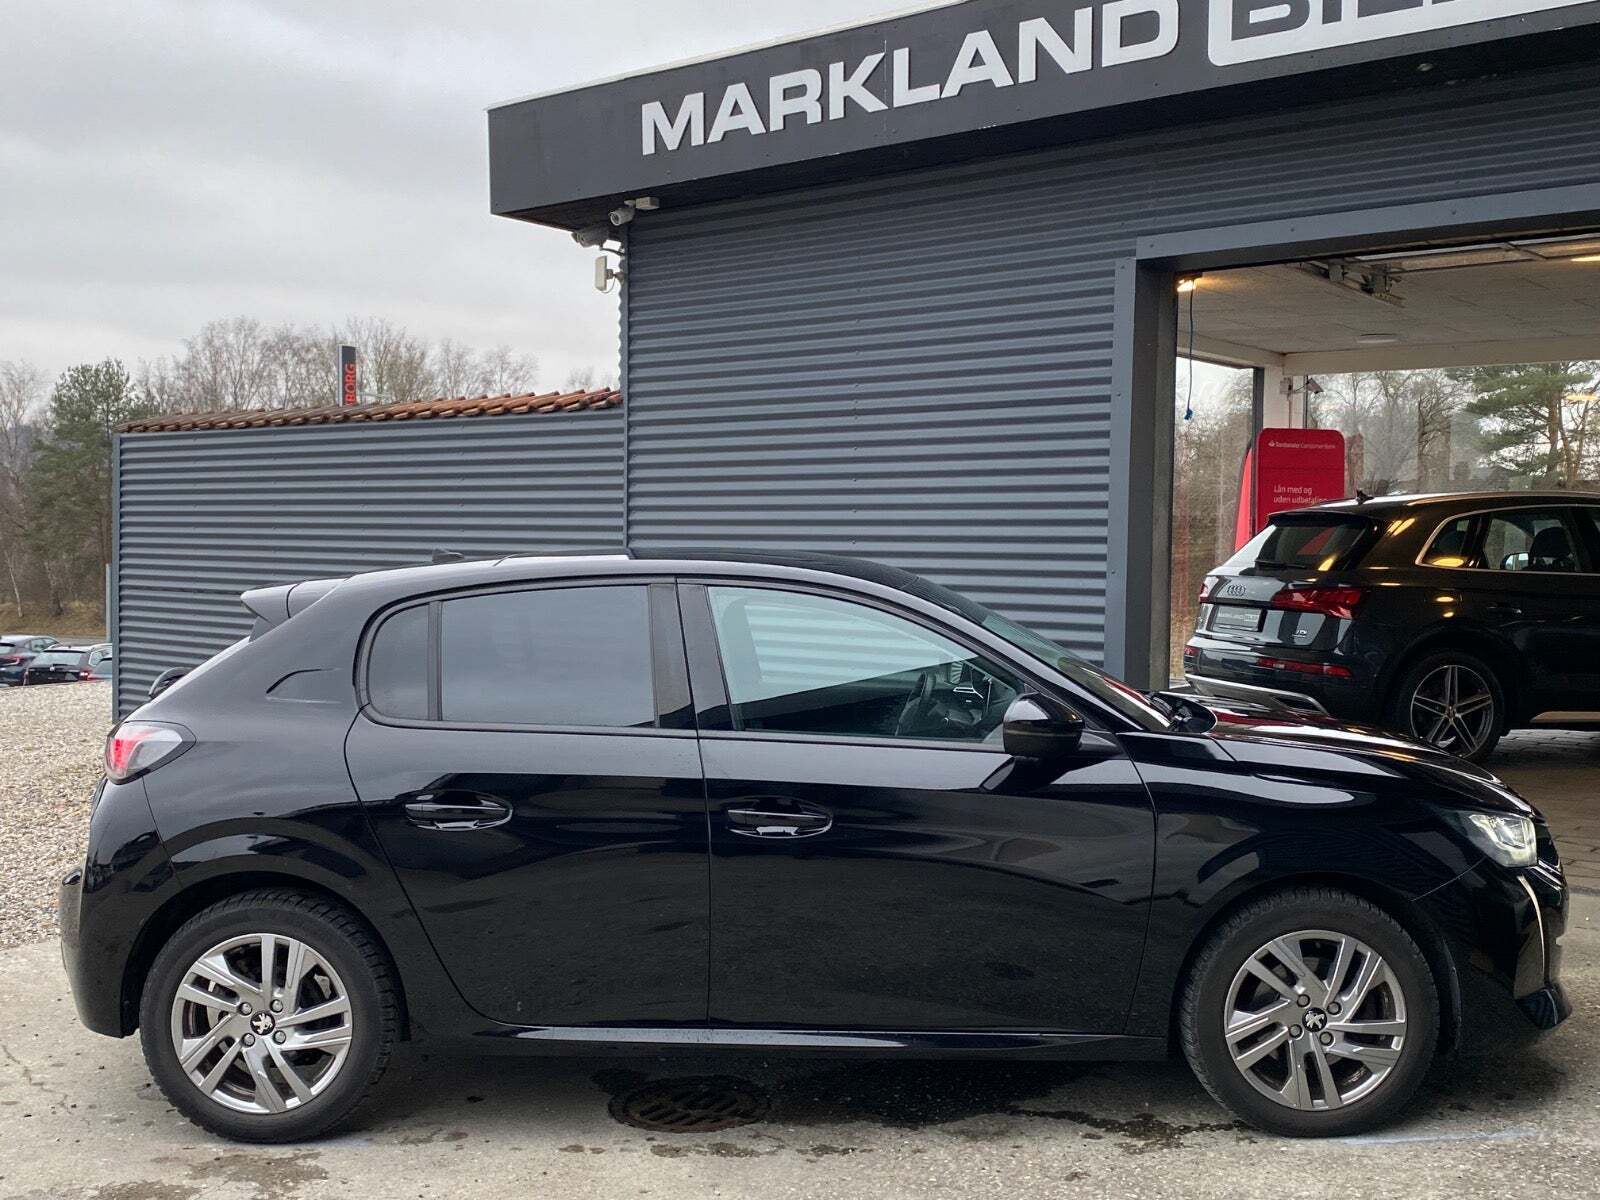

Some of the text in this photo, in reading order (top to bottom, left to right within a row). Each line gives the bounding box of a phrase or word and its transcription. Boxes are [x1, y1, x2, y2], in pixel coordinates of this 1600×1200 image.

[642, 0, 1179, 155] MARKLAND
[1287, 486, 1302, 494] med
[1303, 487, 1312, 496] og
